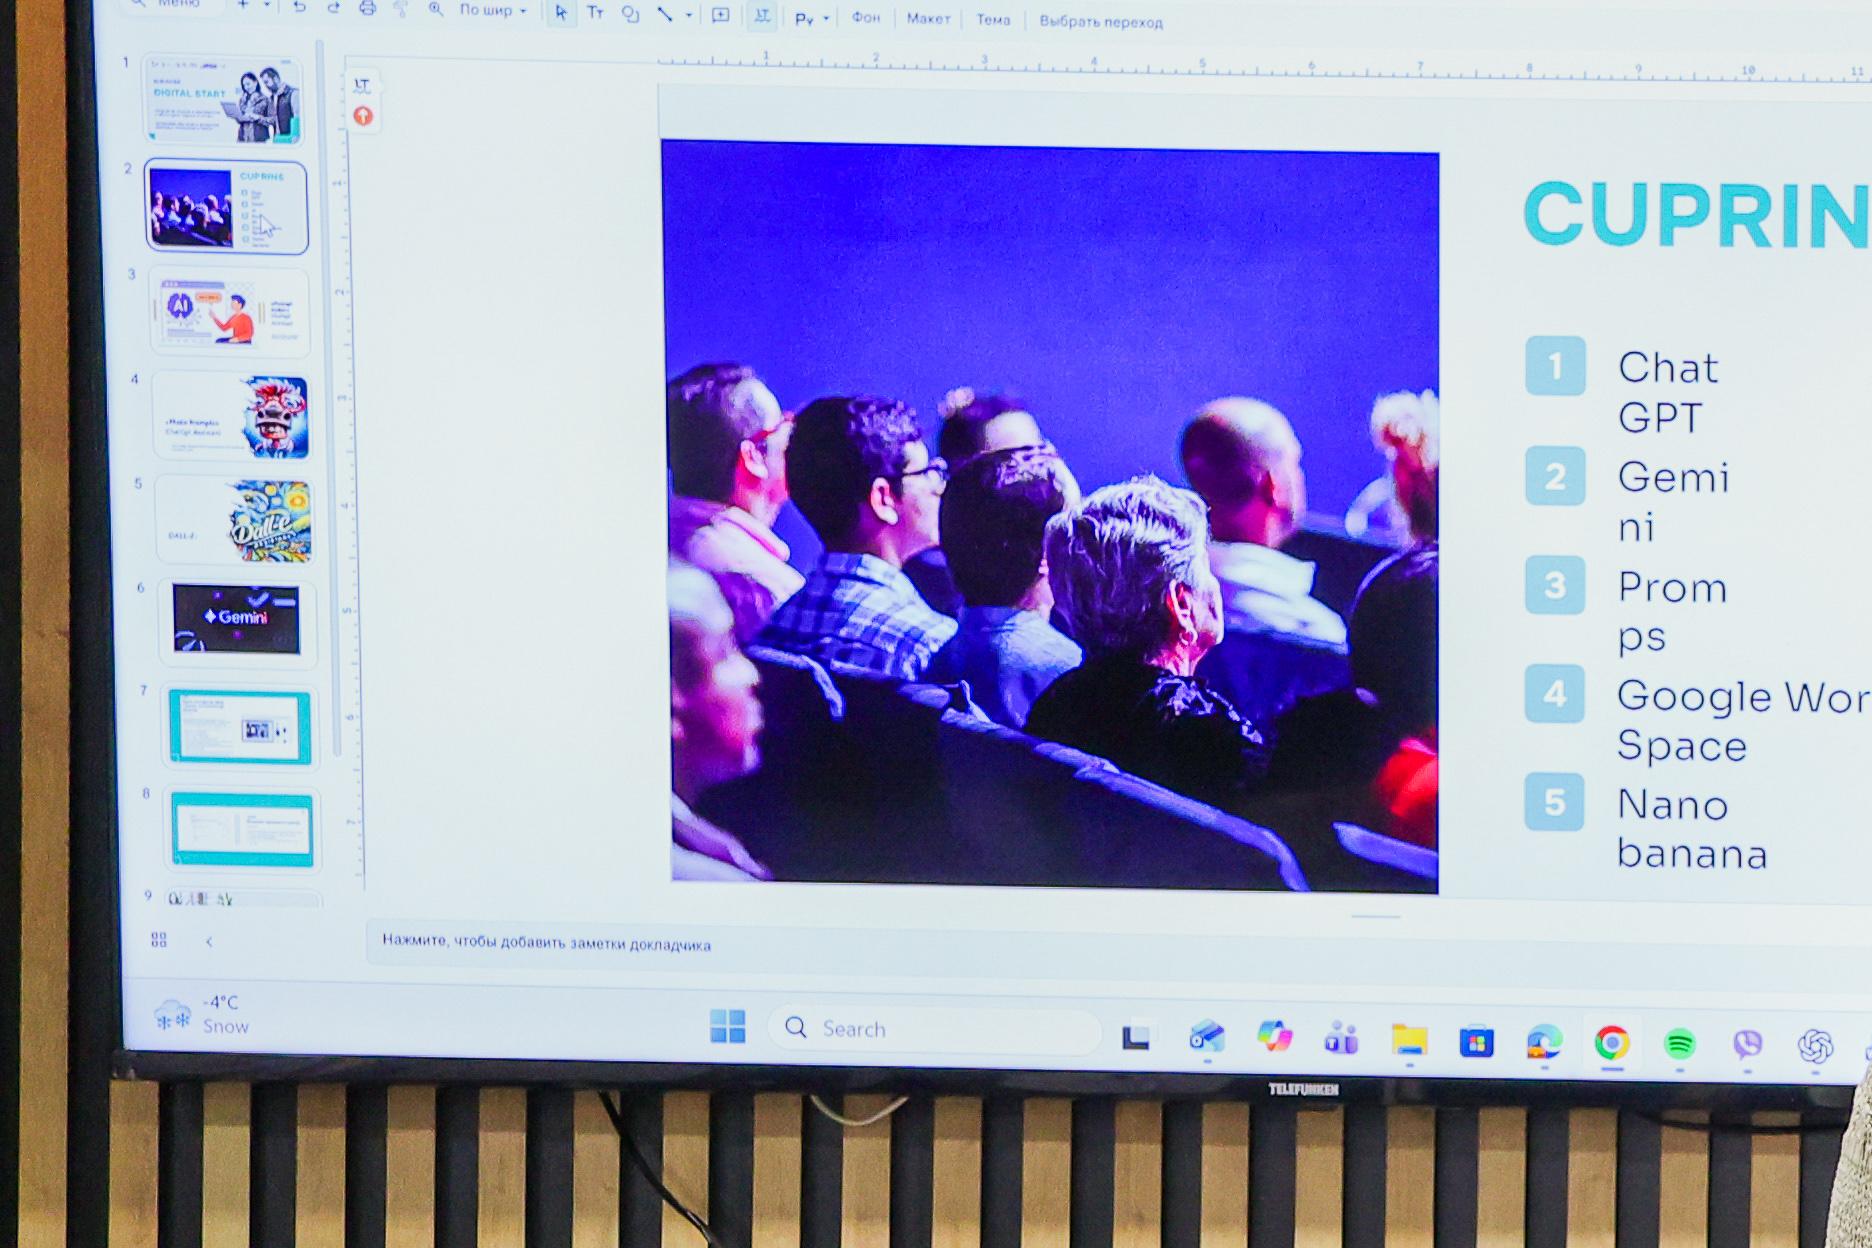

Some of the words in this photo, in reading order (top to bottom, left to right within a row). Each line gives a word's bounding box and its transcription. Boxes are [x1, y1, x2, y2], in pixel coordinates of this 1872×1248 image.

[460, 2, 480, 16] По
[483, 7, 513, 19] шир
[852, 11, 881, 24] Фон
[907, 12, 951, 24] Макет
[977, 13, 1010, 26] Тема
[1039, 14, 1101, 30] Выбрать
[1104, 18, 1164, 31] переход
[123, 55, 129, 68] 1
[1741, 65, 1757, 75] 10
[1851, 66, 1865, 76] 11
[153, 88, 192, 98] DIGITAL
[123, 161, 132, 175] 2
[127, 267, 136, 281] 3
[1548, 351, 1562, 380] 1
[1619, 350, 1719, 384] Chat
[130, 373, 139, 385] 4
[1619, 401, 1703, 434] GPT
[134, 477, 143, 490] 5
[1545, 462, 1566, 490] 2
[1619, 460, 1728, 493] Gemi
[1619, 511, 1653, 542] ni
[137, 583, 145, 593] 6
[1544, 571, 1567, 600] 3
[1620, 570, 1727, 603] Prom
[218, 609, 268, 624] Gemini
[1619, 627, 1666, 658] ps
[140, 684, 148, 696] 7
[1543, 679, 1568, 708] 4
[1618, 678, 1772, 720] Google
[1617, 728, 1747, 768] Space
[142, 787, 150, 799] 8
[1544, 788, 1566, 817] 5
[1619, 788, 1728, 821] Nano
[1618, 836, 1767, 870] banana
[144, 890, 152, 901] 9
[383, 933, 450, 948] Нажмите,
[454, 935, 497, 948] чтобы
[500, 936, 566, 950] добавить
[570, 939, 626, 951] заметки
[629, 940, 712, 954] докладчика
[203, 995, 239, 1011] -4°C
[203, 1018, 249, 1034] Snow
[822, 1020, 886, 1039] Search
[1269, 1082, 1339, 1097] TELEFUNKEN
